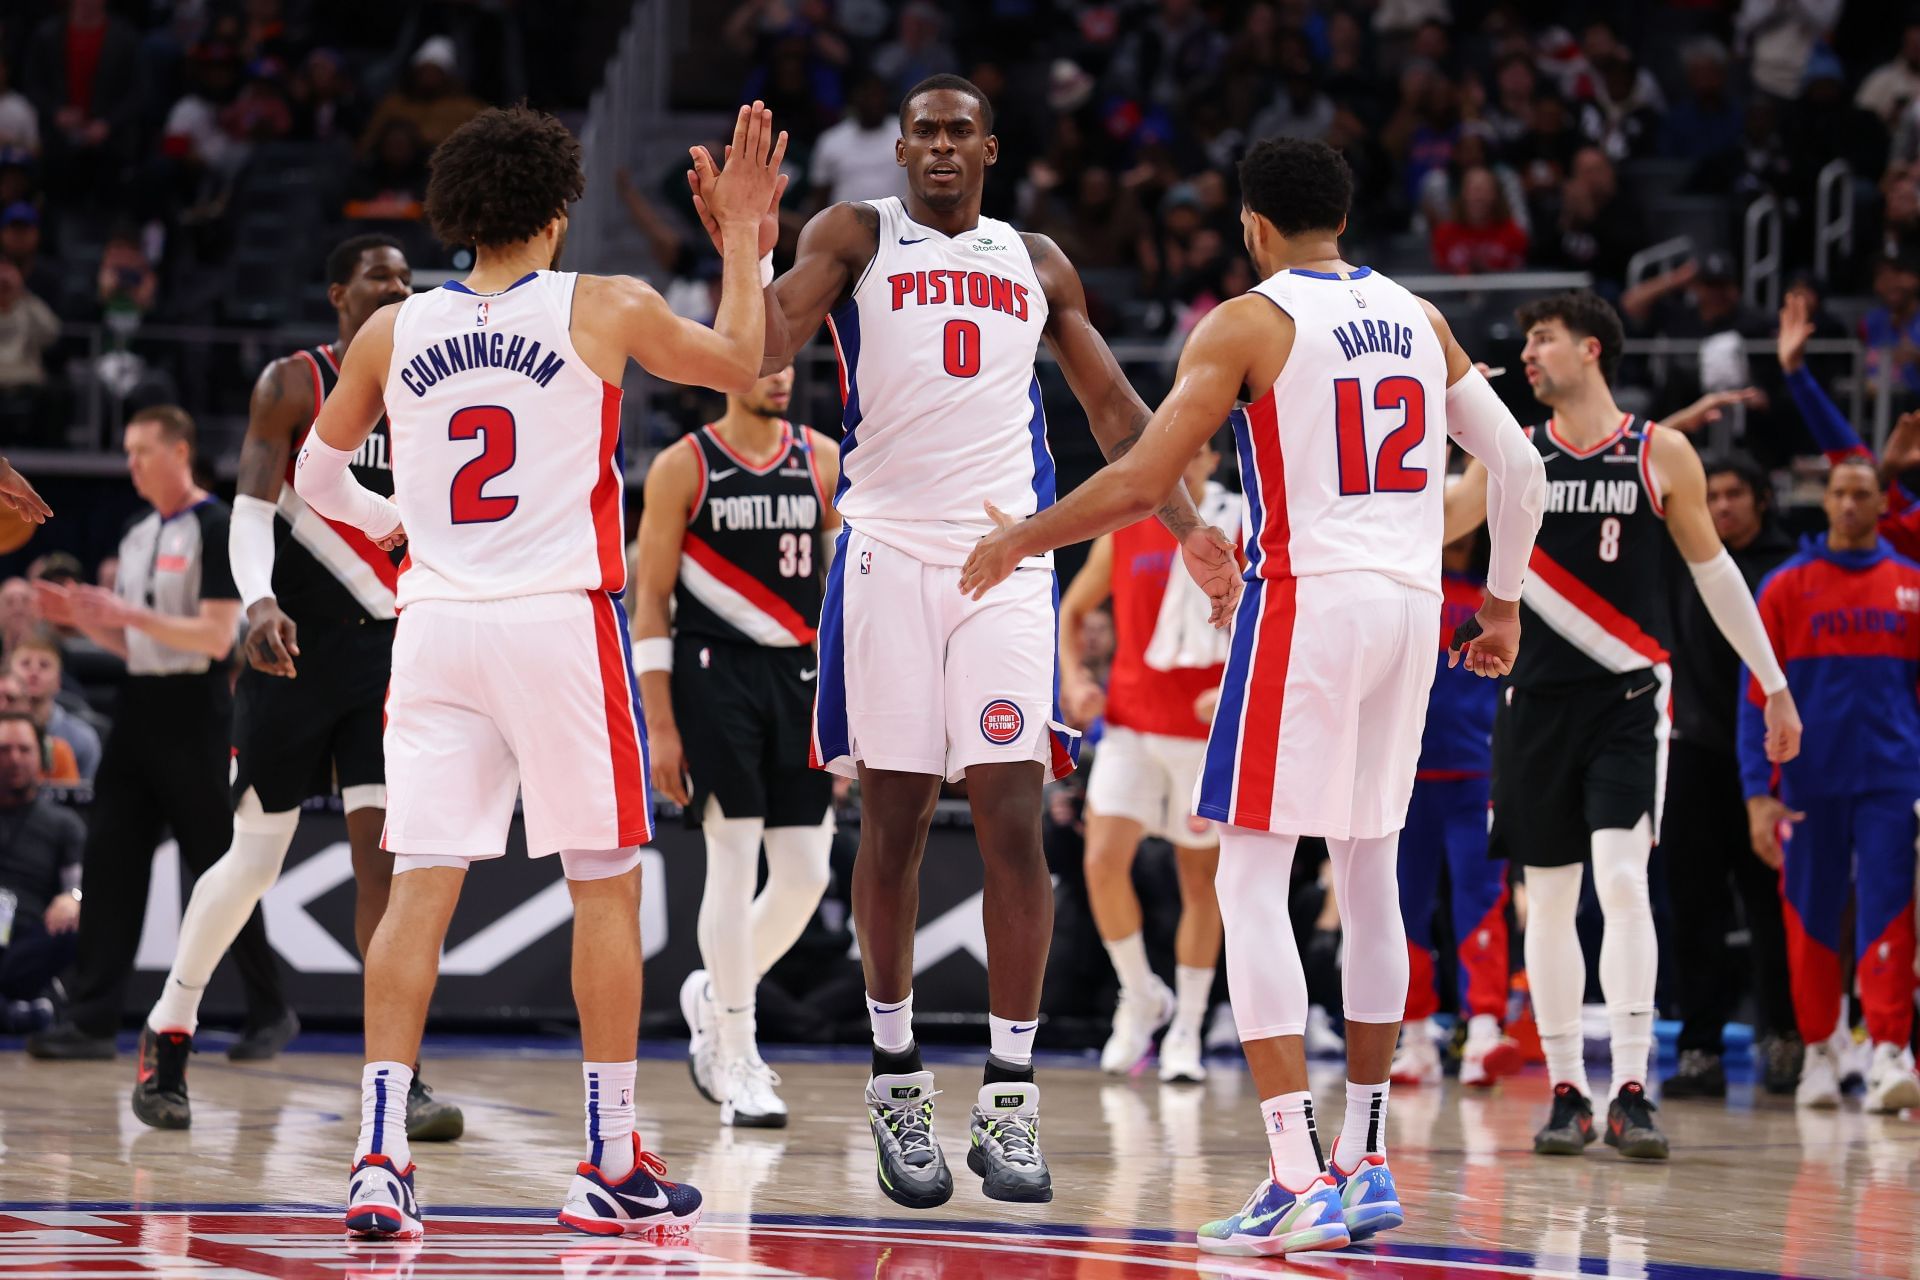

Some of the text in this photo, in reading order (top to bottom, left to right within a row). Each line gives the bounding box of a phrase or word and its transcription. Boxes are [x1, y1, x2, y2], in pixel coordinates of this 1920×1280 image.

[887, 269, 1029, 322] PISTONS
[943, 319, 980, 379] 0
[1332, 319, 1413, 362] HARRIS
[400, 331, 566, 398] CUNNINGHAM
[1333, 375, 1428, 497] 12
[448, 404, 519, 525] 2
[708, 493, 817, 532] PORTLAND
[778, 532, 812, 578] 33
[1598, 516, 1622, 563] 8
[988, 714, 1016, 723] DETROIT
[988, 721, 1016, 730] PISTONS
